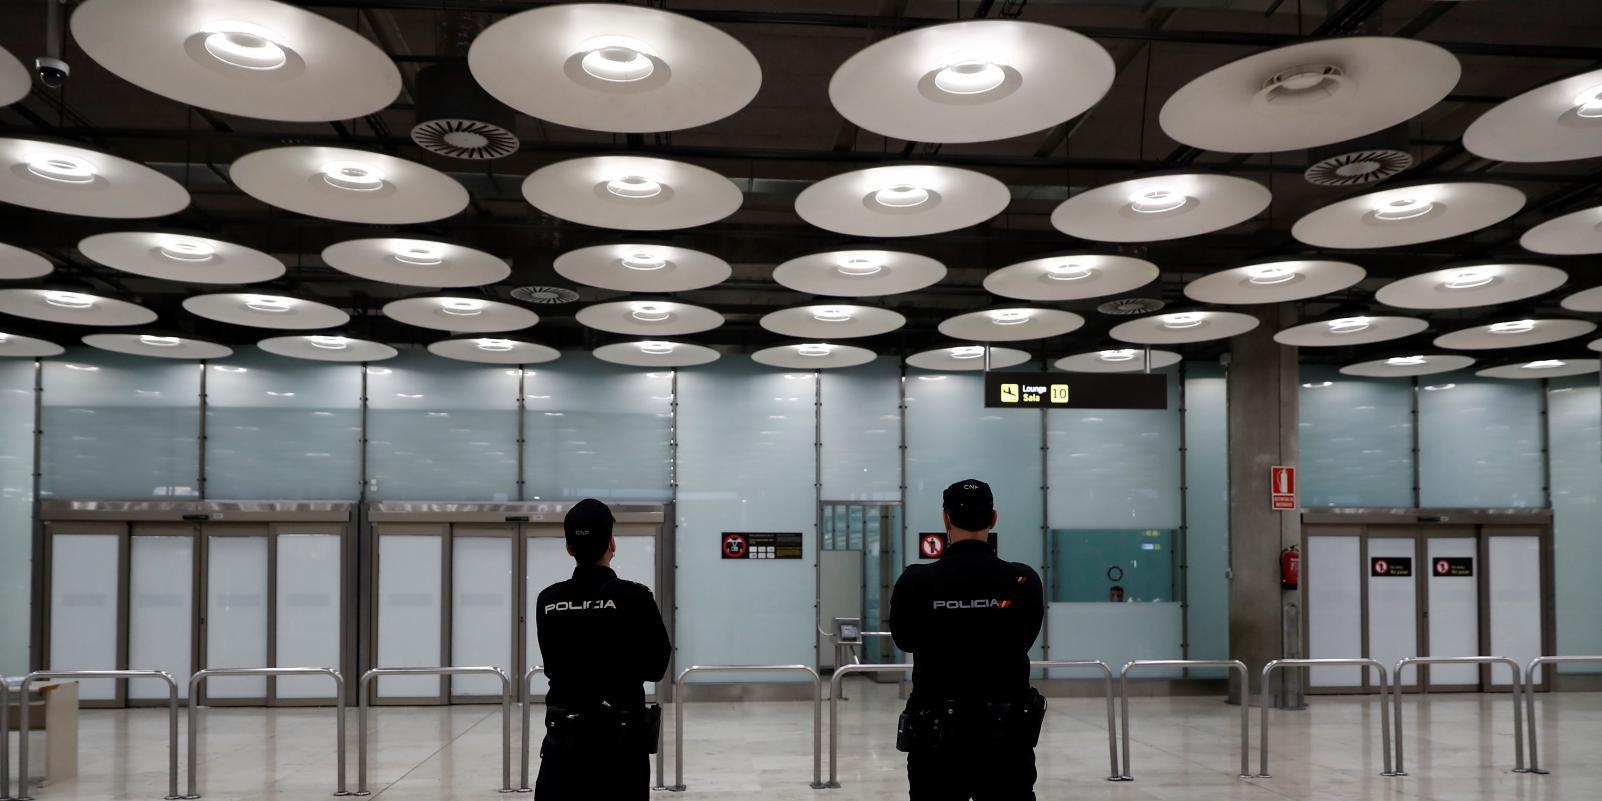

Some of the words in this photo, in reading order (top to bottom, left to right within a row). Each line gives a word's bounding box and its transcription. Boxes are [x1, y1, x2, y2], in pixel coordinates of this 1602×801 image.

[1022, 384, 1047, 394] Lounge
[1053, 388, 1067, 399] 10
[1023, 393, 1041, 402] Sala
[544, 599, 617, 615] POLICIA
[933, 598, 1000, 610] POLICIA
